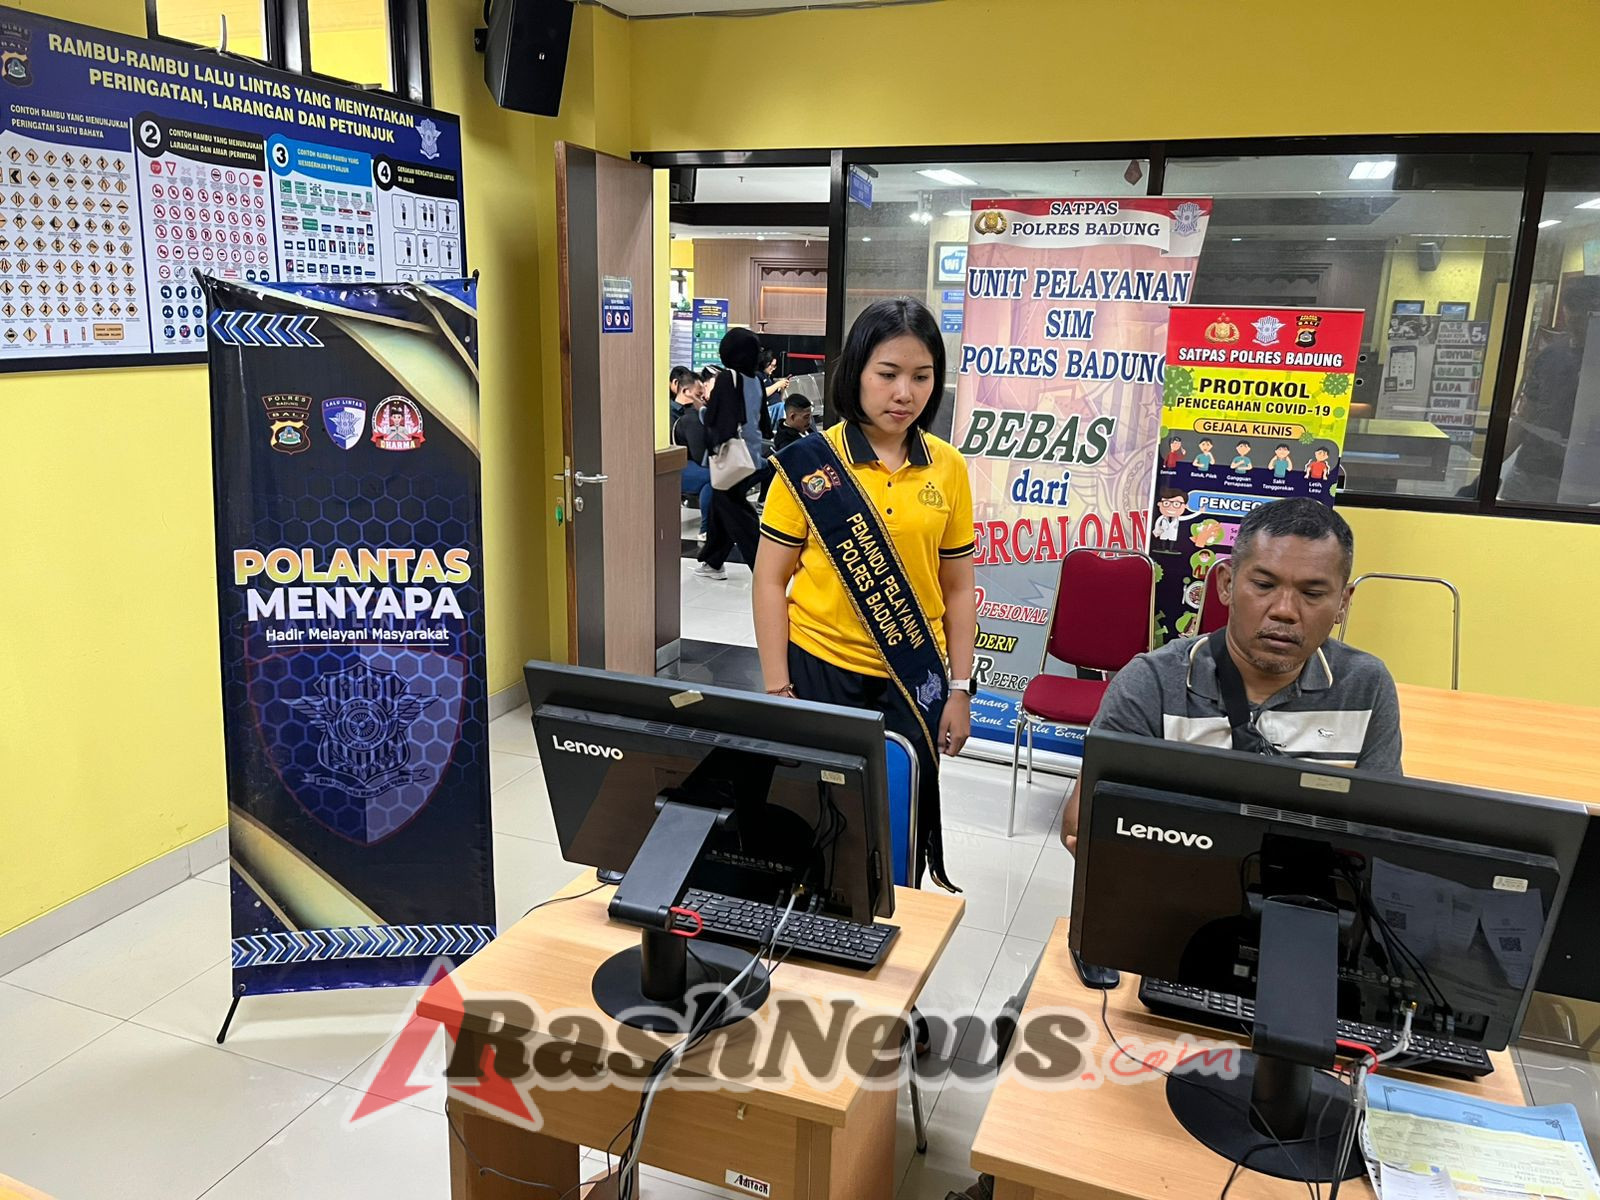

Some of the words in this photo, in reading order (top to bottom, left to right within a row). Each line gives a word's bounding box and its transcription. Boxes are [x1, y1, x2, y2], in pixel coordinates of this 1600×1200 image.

[48, 33, 189, 78] RAMBU-RAMBU
[194, 64, 235, 88] LALU
[239, 76, 291, 100] LINTAS
[294, 87, 332, 110] YANG
[335, 97, 414, 128] MENYATAKAN
[89, 68, 208, 109] PERINGATAN,
[212, 92, 294, 123] LARANGAN
[298, 110, 326, 129] DAN
[330, 117, 395, 143] PETUNJUK
[10, 104, 40, 117] CONTOH
[41, 108, 65, 120] RAMBU
[66, 112, 84, 123] YANG
[85, 115, 129, 129] MENUNJUKAN
[11, 119, 55, 132] PERINGATAN
[56, 123, 78, 135] SUATU
[79, 127, 104, 139] BAHAYA
[145, 124, 158, 144] 2
[168, 128, 193, 139] CONTOH
[193, 132, 212, 142] RAMBU
[213, 135, 228, 144] YANG
[169, 141, 200, 152] LARANGAN
[200, 145, 212, 153] DAN
[275, 145, 287, 164] 3
[380, 165, 390, 181] 4
[1050, 202, 1118, 216] SATPAS
[1011, 222, 1079, 236] POLRES
[1084, 222, 1161, 237] BADUNG
[968, 268, 1027, 297] UNIT
[1033, 270, 1191, 303] PELAYANAN
[1045, 309, 1095, 339] SIM
[960, 345, 1058, 377] POLRES
[1178, 347, 1226, 362] SATPAS
[1229, 351, 1281, 365] POLRES
[1285, 353, 1343, 367] BADUNG
[1199, 378, 1310, 398] PROTOKOL
[325, 400, 341, 408] LALU
[342, 400, 363, 408] LINTAS
[1176, 397, 1261, 412] PENCEGAHAN
[1265, 403, 1331, 416] COVID-19
[958, 410, 1116, 465] BEBAS
[1203, 421, 1248, 434] GEJALA
[1252, 425, 1293, 437] KLINIS
[380, 440, 416, 449] DHARMA
[1012, 468, 1071, 505] dari
[1226, 475, 1252, 483] Gangguan
[974, 510, 1149, 564] ERCALOAN
[233, 547, 472, 585] POLANTAS
[846, 512, 889, 576] PEMANDU
[880, 574, 925, 650] PELAYANAN
[836, 538, 875, 592] POLRES
[866, 592, 902, 646] BADUNG
[246, 586, 465, 621] MENYAPA
[265, 629, 304, 641] Hadir
[308, 628, 367, 642] Melayani
[372, 628, 449, 642] Masyarakat
[970, 697, 1009, 712] emang
[970, 711, 1003, 726] Kami
[551, 734, 624, 761] Lenovo
[1116, 816, 1214, 850] Lenovo
